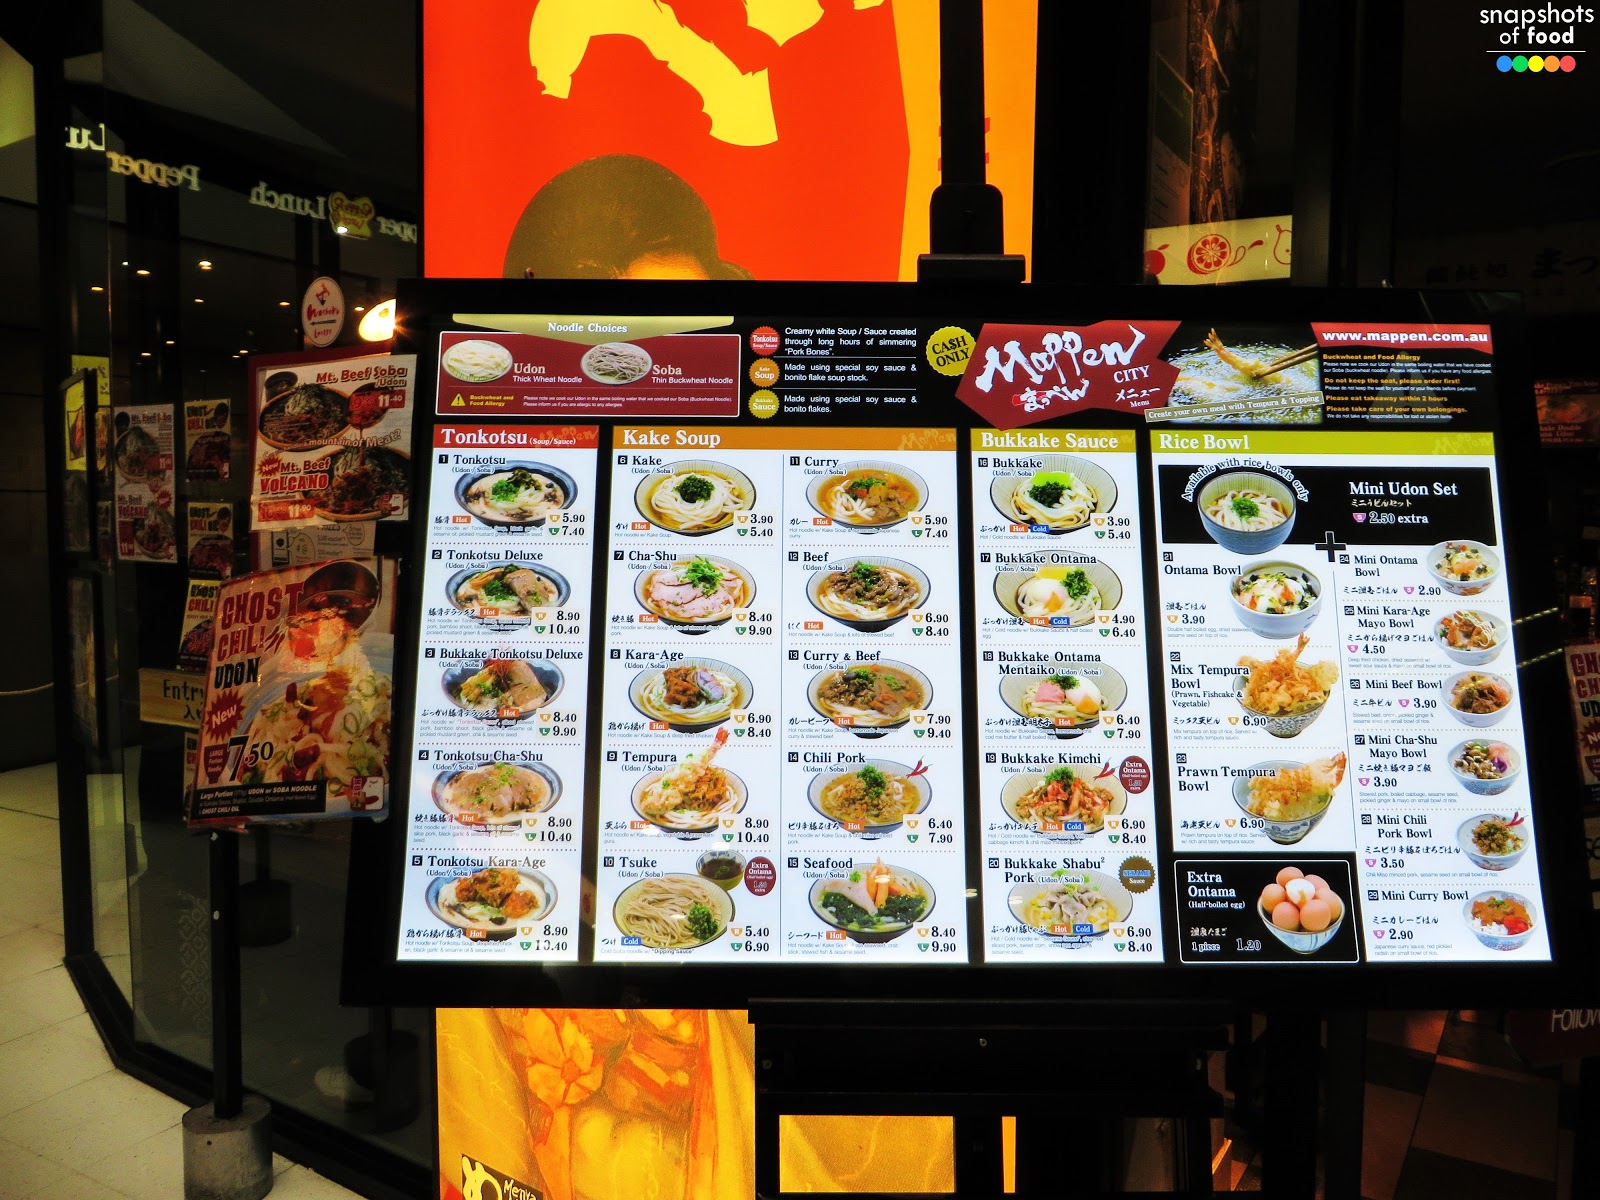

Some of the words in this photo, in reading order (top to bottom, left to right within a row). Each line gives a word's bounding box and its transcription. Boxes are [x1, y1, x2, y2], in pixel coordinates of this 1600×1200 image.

[548, 322, 584, 332] Noodle
[588, 323, 628, 333] Choices
[785, 327, 814, 336] Creamy
[838, 328, 857, 336] Soup
[785, 338, 813, 346] through
[818, 338, 834, 347] long
[879, 339, 916, 347] simmering
[1322, 331, 1488, 343] www.mappen.com.au
[936, 348, 971, 367] ONLY
[975, 324, 1146, 392] Mappen
[513, 363, 545, 375] Udon
[653, 365, 682, 375] Soba
[810, 364, 830, 372] using
[835, 364, 860, 372] special
[316, 373, 338, 383] Mt.
[341, 367, 372, 381] Beef
[374, 365, 408, 379] Soba
[755, 371, 775, 379] Soup
[1113, 365, 1150, 384] CITY
[1115, 386, 1161, 402] メニュー
[1130, 400, 1150, 408] Menu
[1149, 410, 1171, 419] Create
[1174, 408, 1191, 418] your
[1193, 406, 1208, 415] own
[1210, 403, 1226, 413] meal
[1228, 401, 1245, 411] with
[1247, 398, 1279, 409] Tempura
[1281, 397, 1288, 405] &
[1290, 395, 1319, 406] Topping
[441, 429, 528, 445] Tonkotsu
[529, 436, 576, 446] (Soup/Sauce)
[623, 430, 670, 445] Kake
[675, 430, 721, 447] Soup
[981, 432, 1060, 448] Bukkake
[1065, 433, 1118, 449] Sauce
[1159, 433, 1199, 449] Rice
[1203, 434, 1249, 450] Bowl
[453, 455, 506, 465] Tonkotsu
[632, 455, 662, 466] Kake
[805, 457, 839, 468] Curry
[993, 458, 1042, 468] Bukkake
[280, 462, 300, 474] Mt.
[303, 458, 331, 471] Beef
[260, 474, 329, 495] VOLCANO
[1182, 464, 1216, 502] Available
[1218, 458, 1240, 468] with
[1243, 458, 1262, 468] rice
[1266, 461, 1294, 481] bowls
[1293, 478, 1309, 502] only
[1349, 482, 1384, 495] Mini
[1388, 482, 1429, 495] Udon
[1433, 483, 1458, 495] Set
[563, 513, 585, 524] 5.90
[750, 514, 773, 524] 3.90
[1107, 516, 1130, 526] 3.90
[1369, 511, 1395, 523] 2.50
[1398, 513, 1429, 523] extra
[447, 550, 500, 560] Tonkotsu
[504, 550, 543, 560] Deluxe
[629, 551, 677, 561] Cha-Shu
[803, 552, 829, 562] Beef
[995, 553, 1046, 563] Bukkake
[1051, 554, 1097, 564] Ontama
[1164, 565, 1208, 575] Ontama
[1213, 565, 1242, 575] Bowl
[221, 582, 303, 630] GHOST
[1357, 606, 1380, 615] Mini
[1383, 606, 1430, 616] Kara-Age
[557, 611, 580, 621] 8.90
[1182, 614, 1205, 624] 3.90
[1358, 619, 1385, 629] Mayo
[1389, 619, 1414, 628] Bowl
[440, 649, 487, 659] Bukkake
[491, 649, 542, 659] Tonkotsu
[546, 649, 583, 659] Deluxe
[625, 649, 684, 661] Kara-Age
[804, 650, 839, 661] Curry
[856, 650, 881, 661] Beef
[998, 651, 1050, 662] Bukkake
[1055, 652, 1101, 662] Ontama
[214, 657, 260, 690] UDON
[999, 665, 1055, 675] Mentaiko
[1171, 665, 1193, 675] Mix
[1198, 665, 1249, 676] Tempura
[1171, 679, 1200, 689] Bowl
[163, 679, 203, 701] Entr
[1172, 700, 1211, 708] Vegetable)
[211, 705, 237, 726] New
[434, 751, 489, 761] Tonkotsu
[494, 751, 543, 761] Cha-Shu
[622, 752, 677, 764] Tempura
[804, 752, 832, 763] Chili
[837, 752, 866, 763] Pork
[1001, 753, 1054, 764] Bukkake
[1058, 753, 1101, 764] Kimchi
[428, 856, 484, 867] Tonkotsu
[488, 856, 546, 868] Kara-Age
[619, 857, 657, 868] Tsuke
[804, 858, 853, 869] Seafood
[1005, 858, 1057, 869] Bukkake
[1005, 872, 1034, 883] Pork
[1187, 871, 1222, 882] Extra
[1188, 886, 1236, 897] Ontama
[1382, 891, 1405, 901] Mini
[1409, 891, 1439, 902] Curry
[1443, 891, 1469, 900] Bowl
[1230, 901, 1245, 909] egg)
[1389, 929, 1413, 940] 2.90
